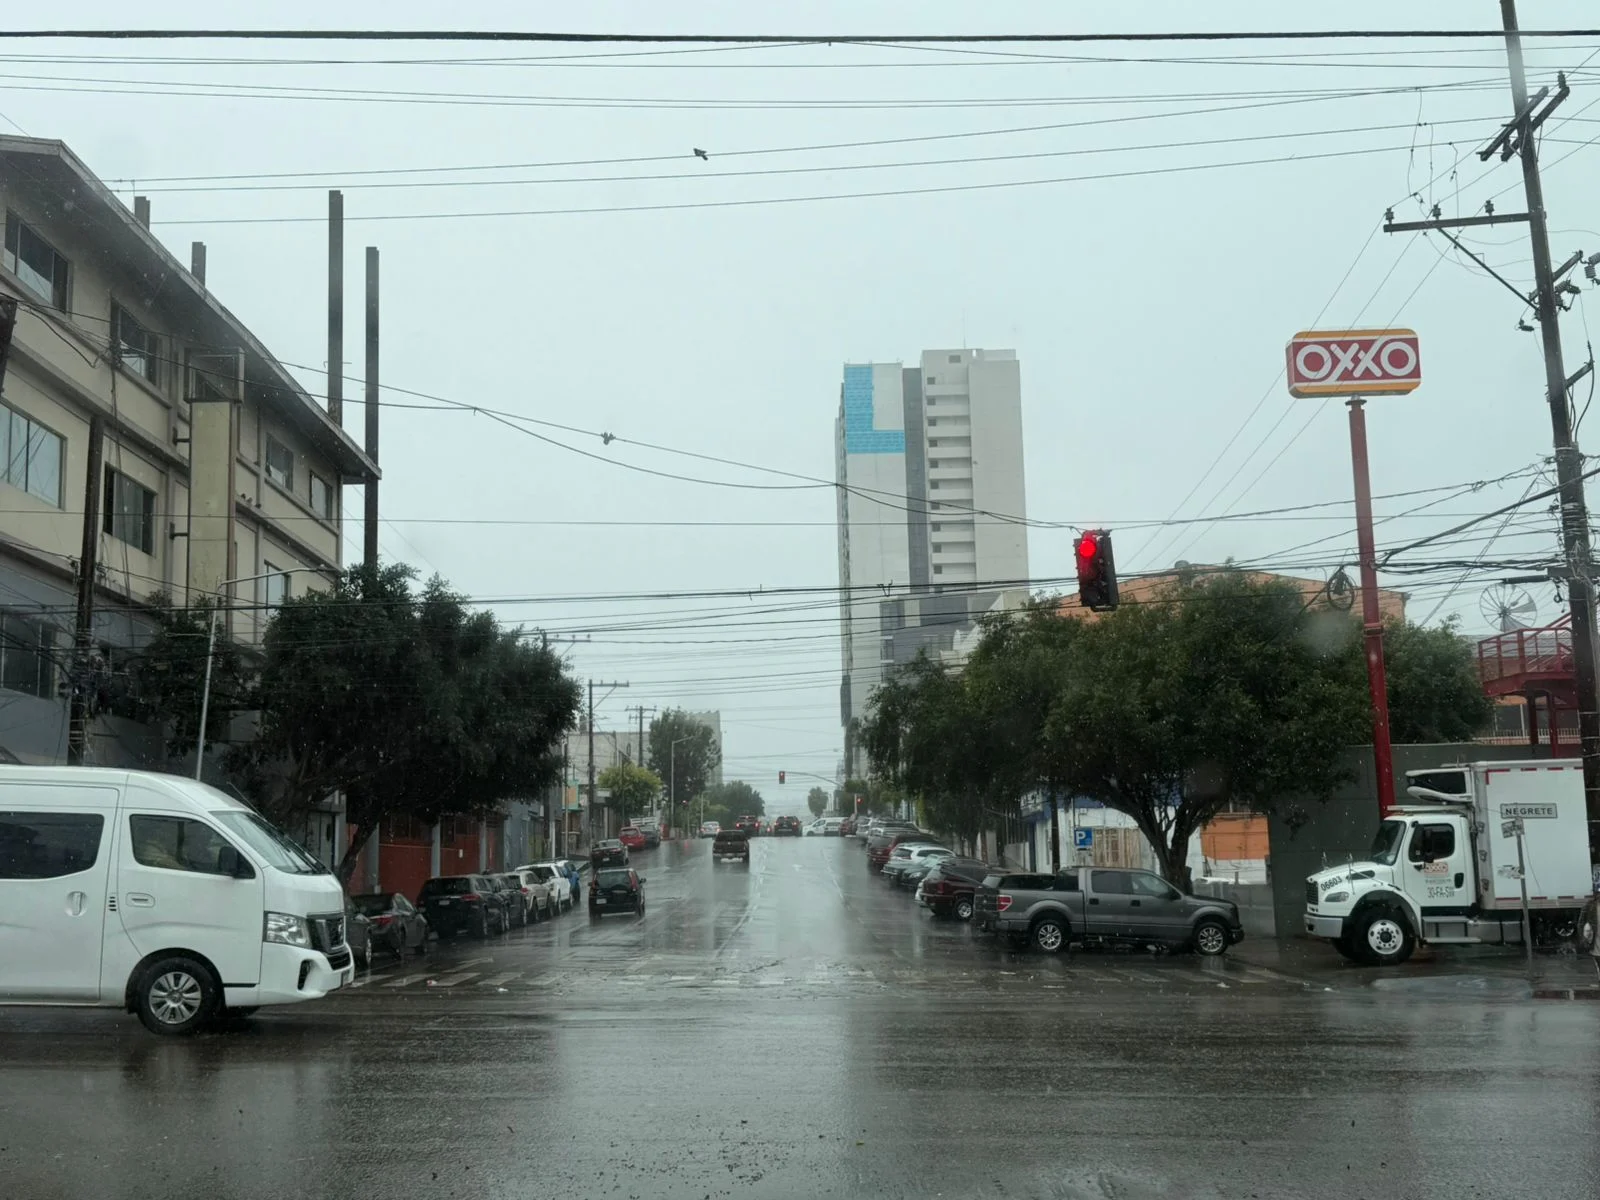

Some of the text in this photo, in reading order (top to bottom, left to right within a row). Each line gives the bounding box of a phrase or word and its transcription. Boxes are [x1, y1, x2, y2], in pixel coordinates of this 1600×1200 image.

[1296, 338, 1417, 382] OXXO
[1505, 807, 1553, 815] NEGRETE
[1076, 831, 1086, 844] P
